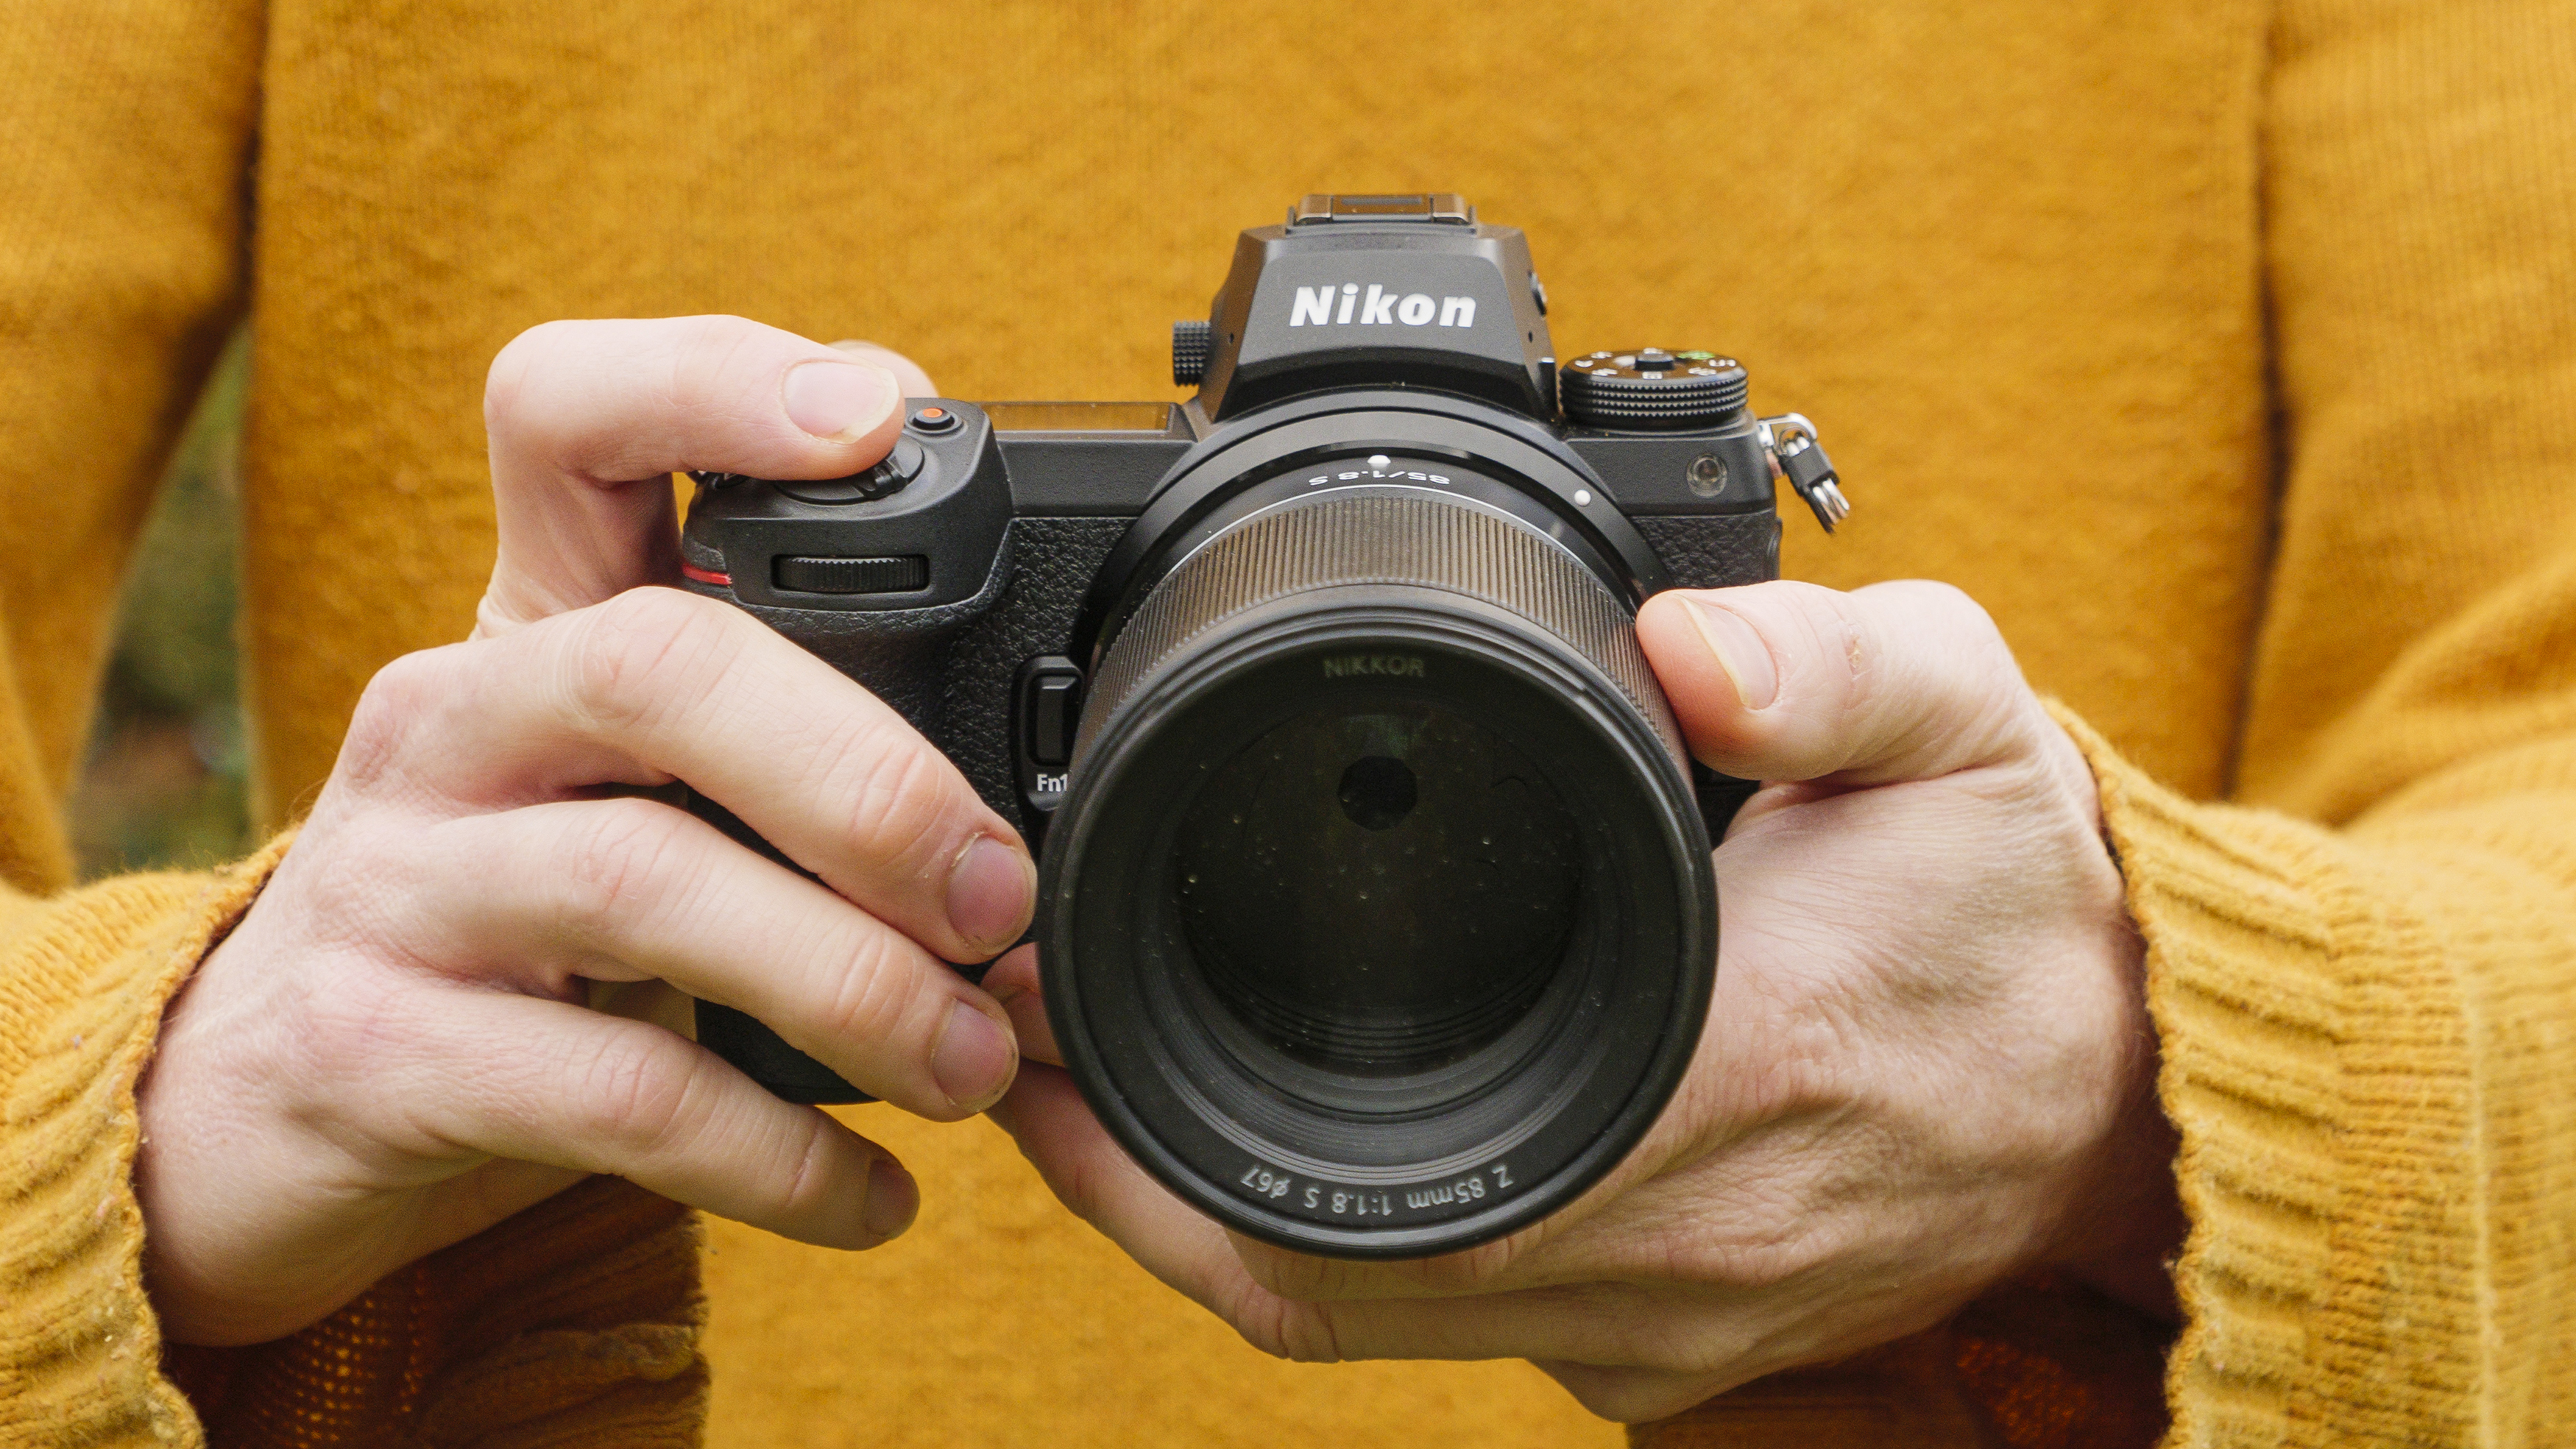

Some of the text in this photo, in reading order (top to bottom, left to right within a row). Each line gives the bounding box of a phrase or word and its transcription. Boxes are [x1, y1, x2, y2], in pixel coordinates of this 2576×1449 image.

[1289, 283, 1476, 327] Nikon
[1309, 470, 1450, 486] 85/1.8 S
[1323, 656, 1425, 678] NIKKOR
[1037, 773, 1068, 792] Fn1
[1491, 1164, 1514, 1189] Z
[1303, 1186, 1320, 1209] S
[1331, 1191, 1392, 1216] 1:1.8
[1406, 1177, 1487, 1209] 85mm
